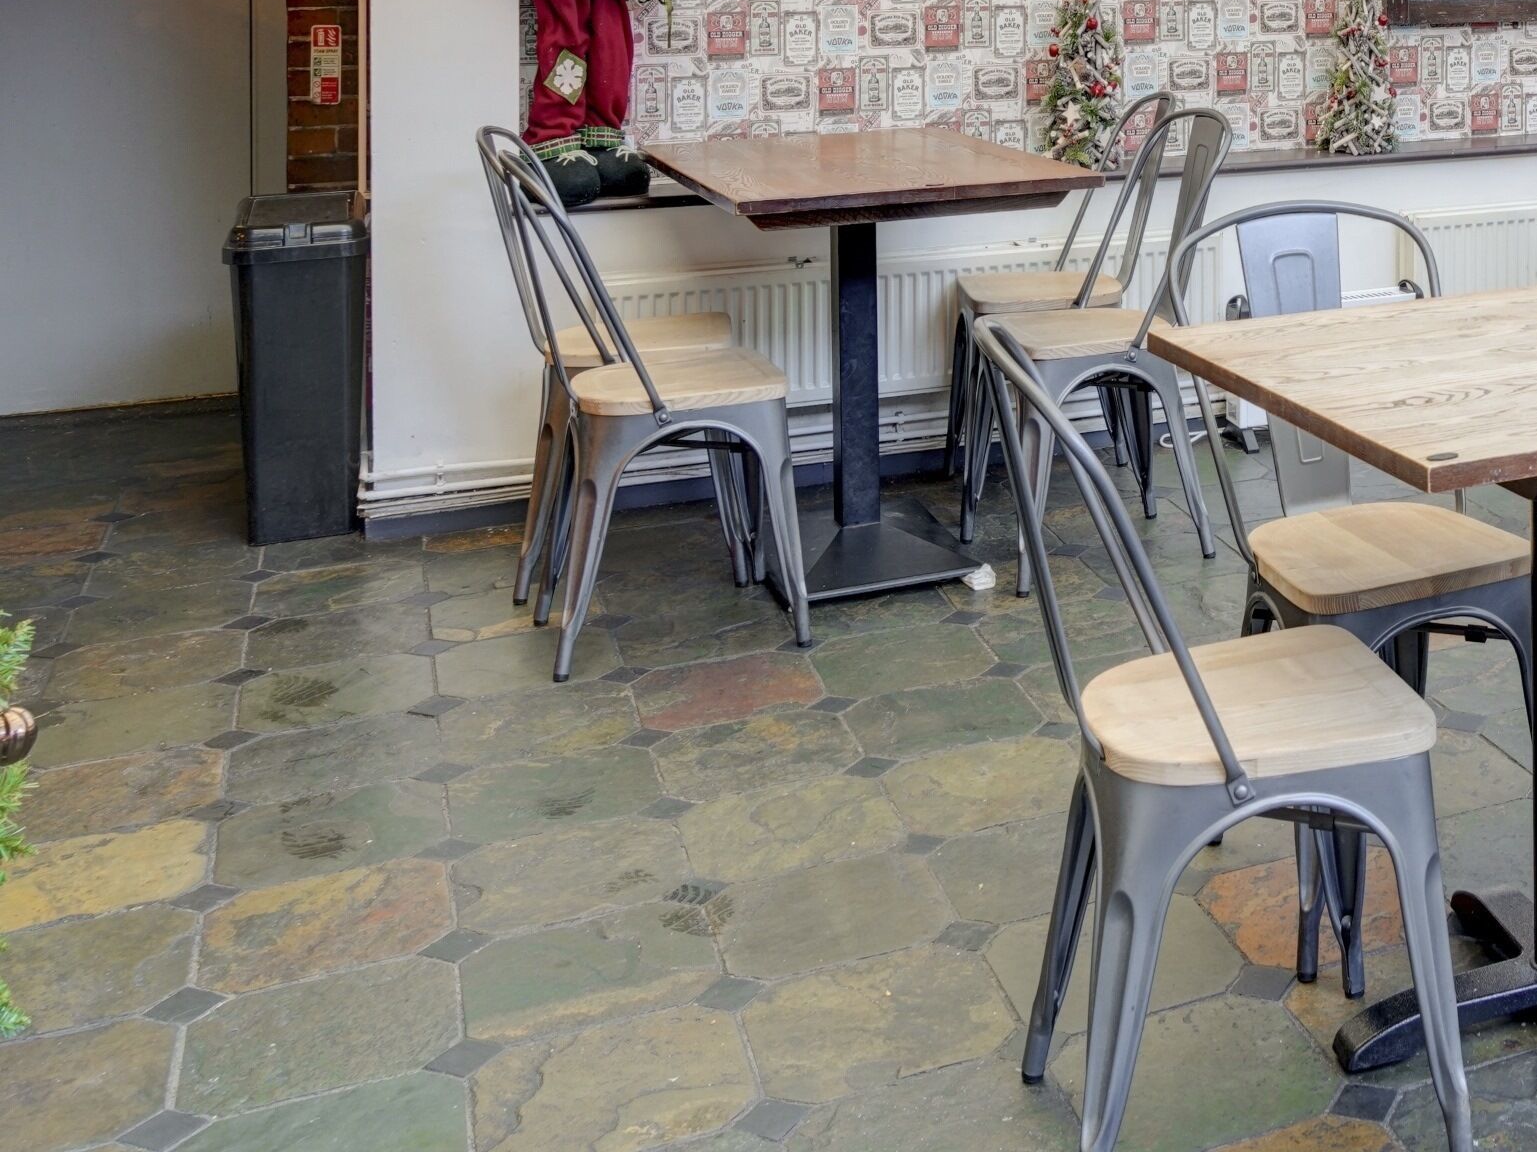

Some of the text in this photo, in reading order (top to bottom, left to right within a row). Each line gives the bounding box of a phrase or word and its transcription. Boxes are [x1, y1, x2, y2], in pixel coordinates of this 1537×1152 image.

[998, 22, 1020, 31] BAKER
[788, 28, 812, 38] BAKER
[826, 37, 853, 46] VODKA
[896, 83, 919, 93] BAKER
[675, 93, 701, 103] BAKER
[932, 91, 958, 100] VODKA
[715, 101, 743, 111] VODKA
